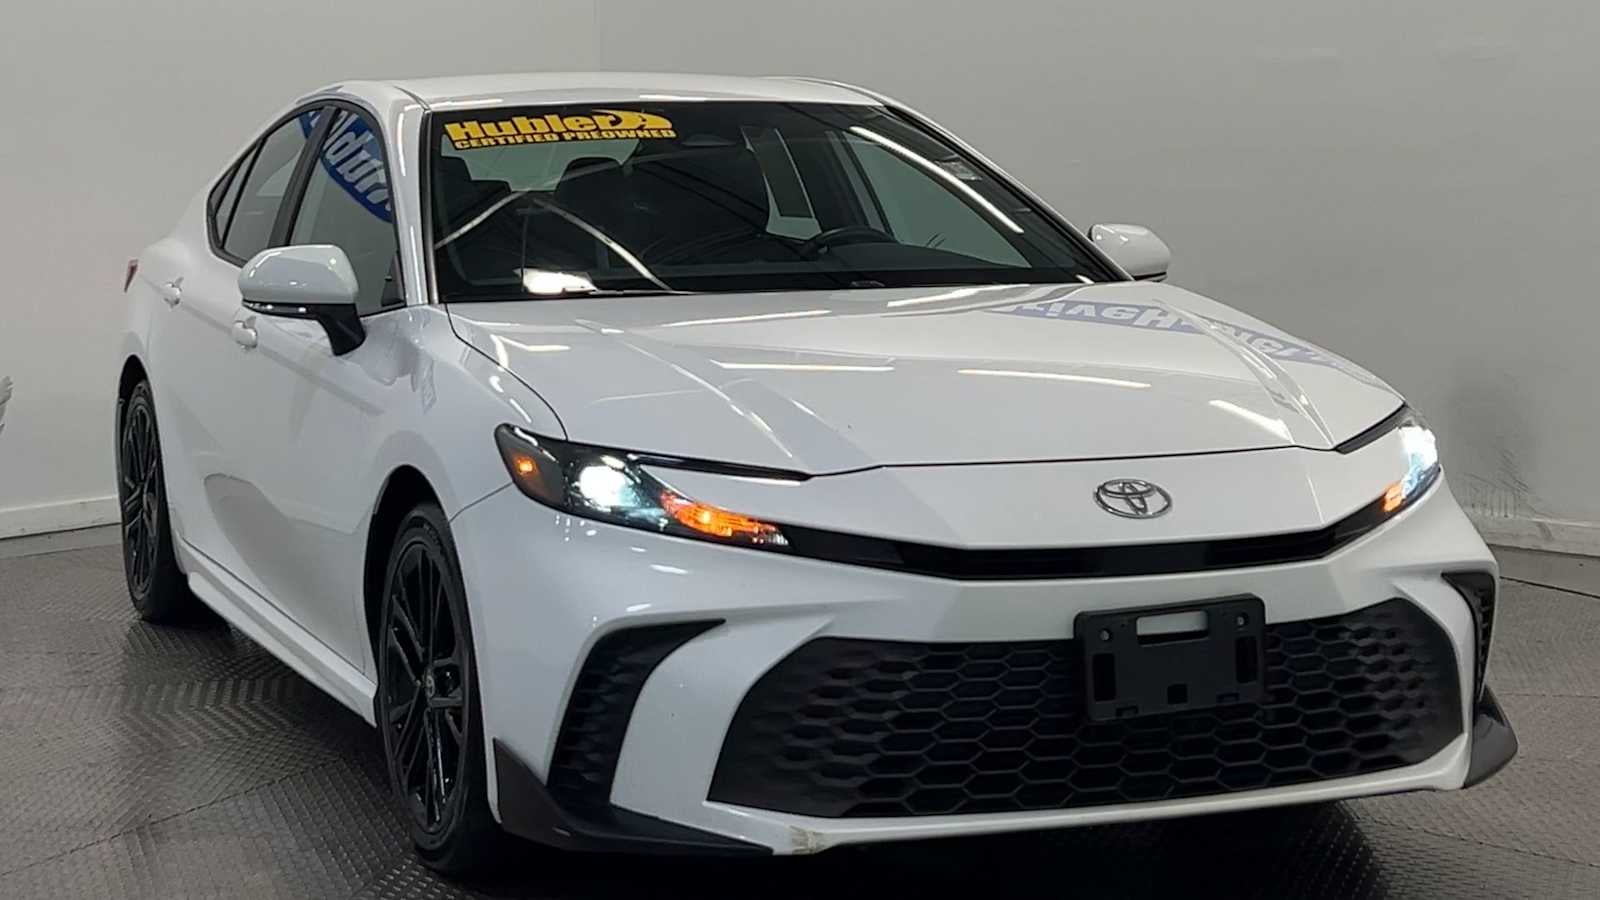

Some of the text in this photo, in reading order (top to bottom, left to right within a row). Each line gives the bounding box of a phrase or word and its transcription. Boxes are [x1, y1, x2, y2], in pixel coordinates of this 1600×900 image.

[445, 114, 617, 140] Hubler
[454, 129, 676, 149] CERTIFIED PREOWNED
